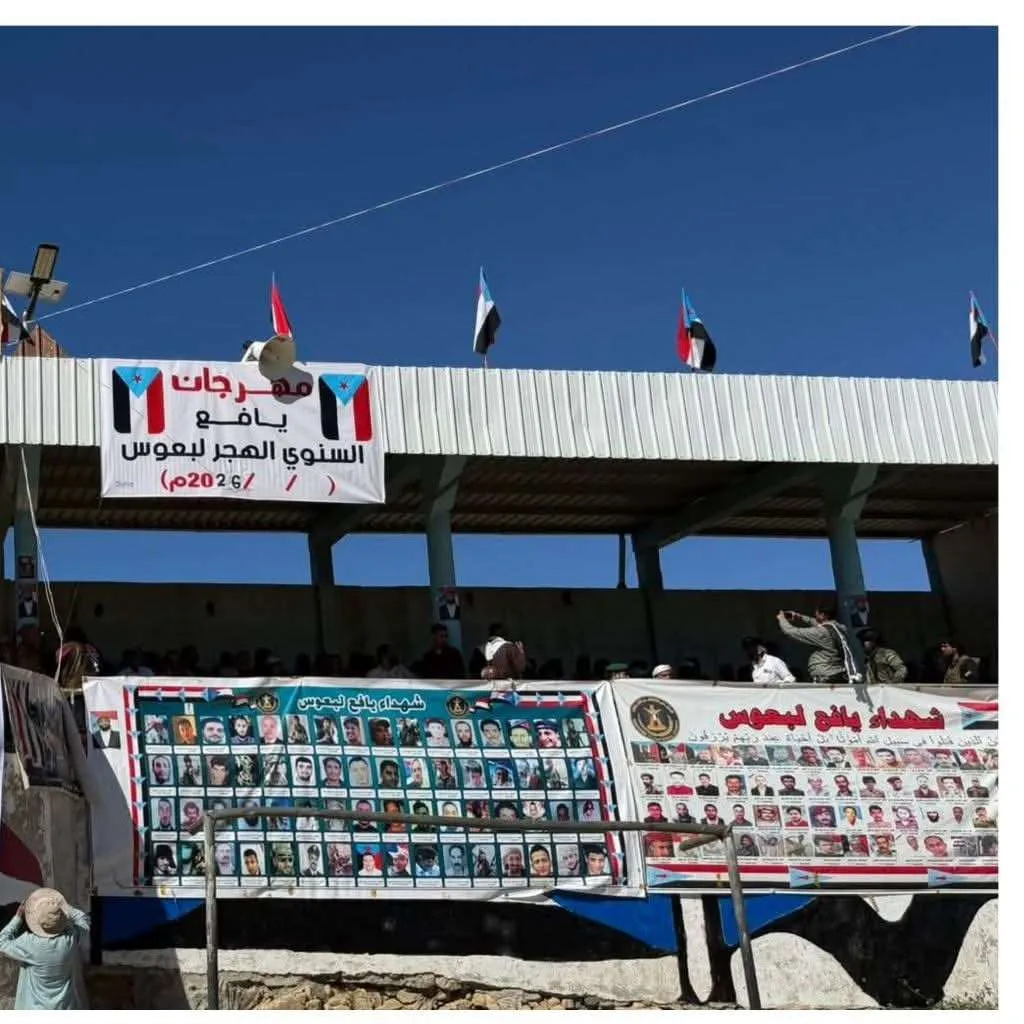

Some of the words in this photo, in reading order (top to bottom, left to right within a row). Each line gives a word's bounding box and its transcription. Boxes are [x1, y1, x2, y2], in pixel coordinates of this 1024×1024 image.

[171, 366, 313, 403] مهرجان
[195, 407, 288, 433] يافع
[121, 438, 206, 465] لبعوس
[213, 440, 275, 464] الهجر
[282, 445, 364, 470] السنوي
[297, 693, 346, 712] لبعوس
[347, 693, 377, 713] يافع
[378, 693, 426, 713] شهداء
[719, 704, 806, 731] لبعوس
[814, 704, 862, 732] يافع
[869, 705, 944, 730] شهداء
